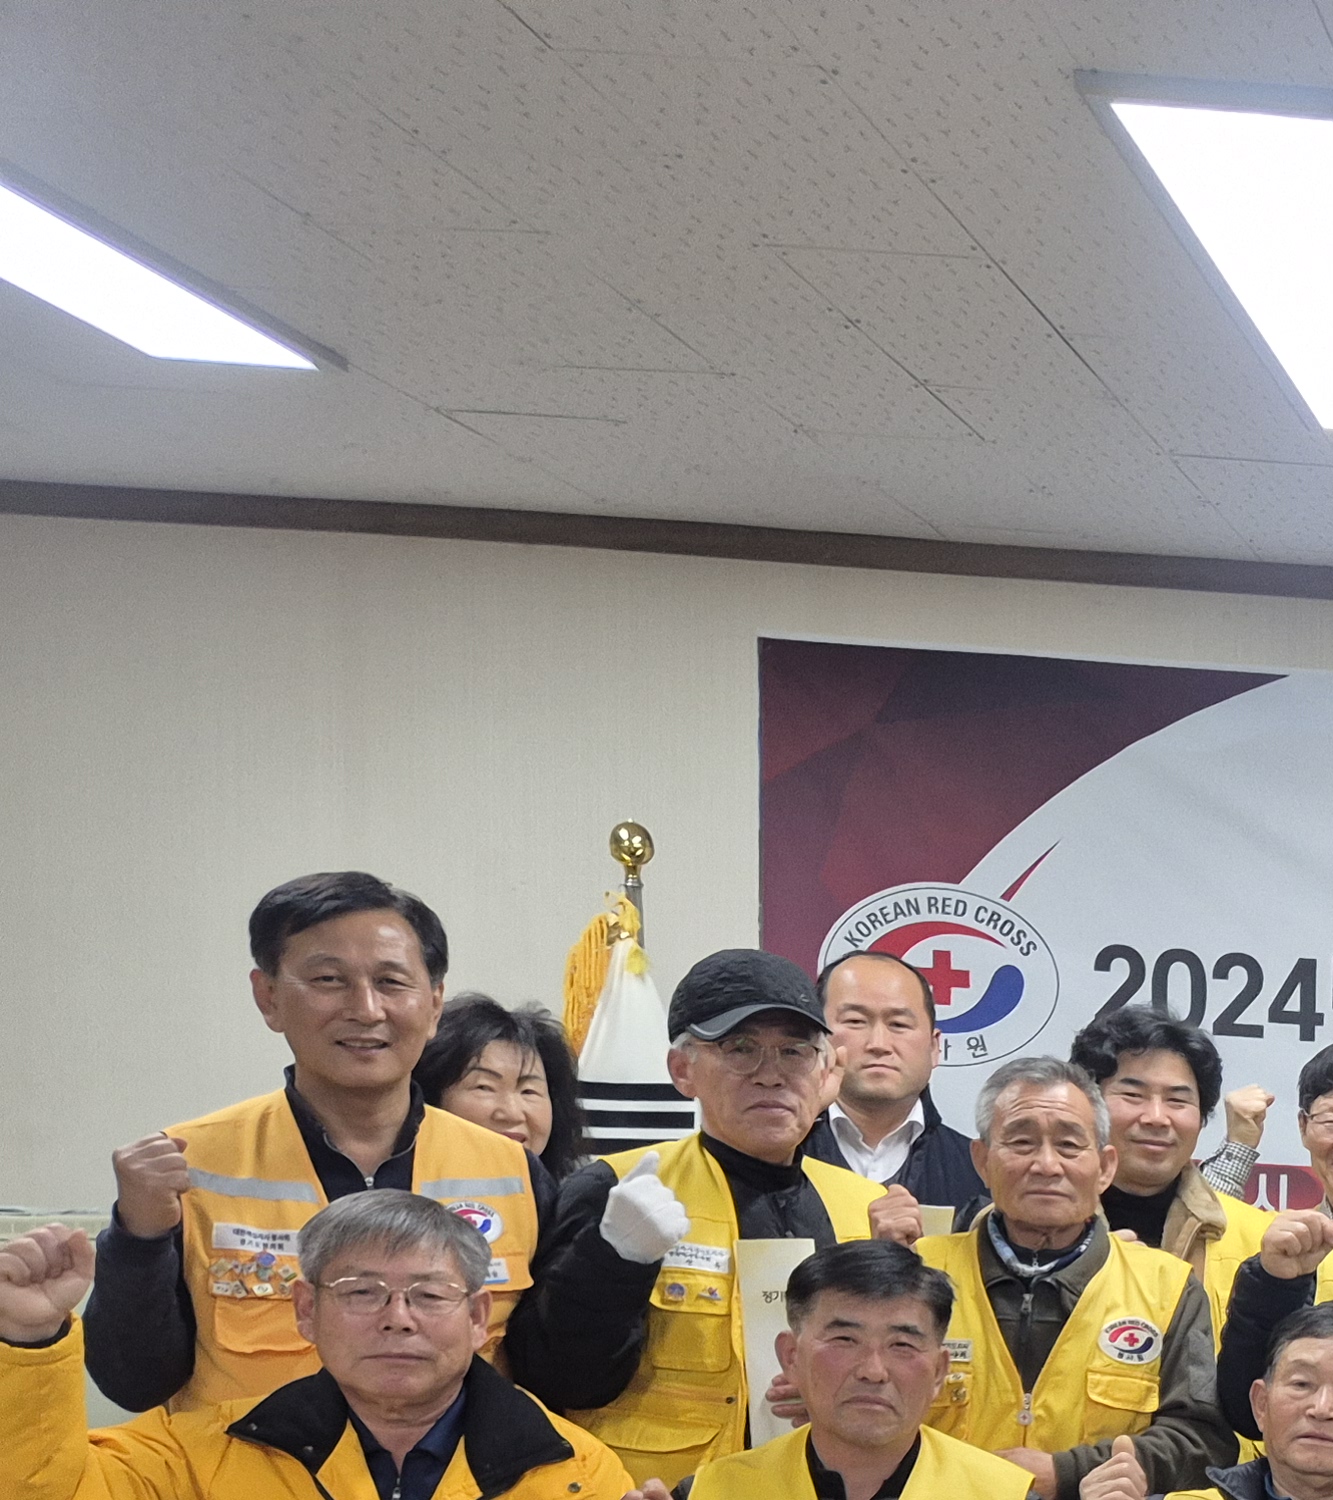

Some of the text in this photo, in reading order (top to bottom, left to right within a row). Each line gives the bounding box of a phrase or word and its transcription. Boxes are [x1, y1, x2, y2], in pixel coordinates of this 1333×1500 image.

[843, 896, 1038, 957] KOREAN RED CROSS
